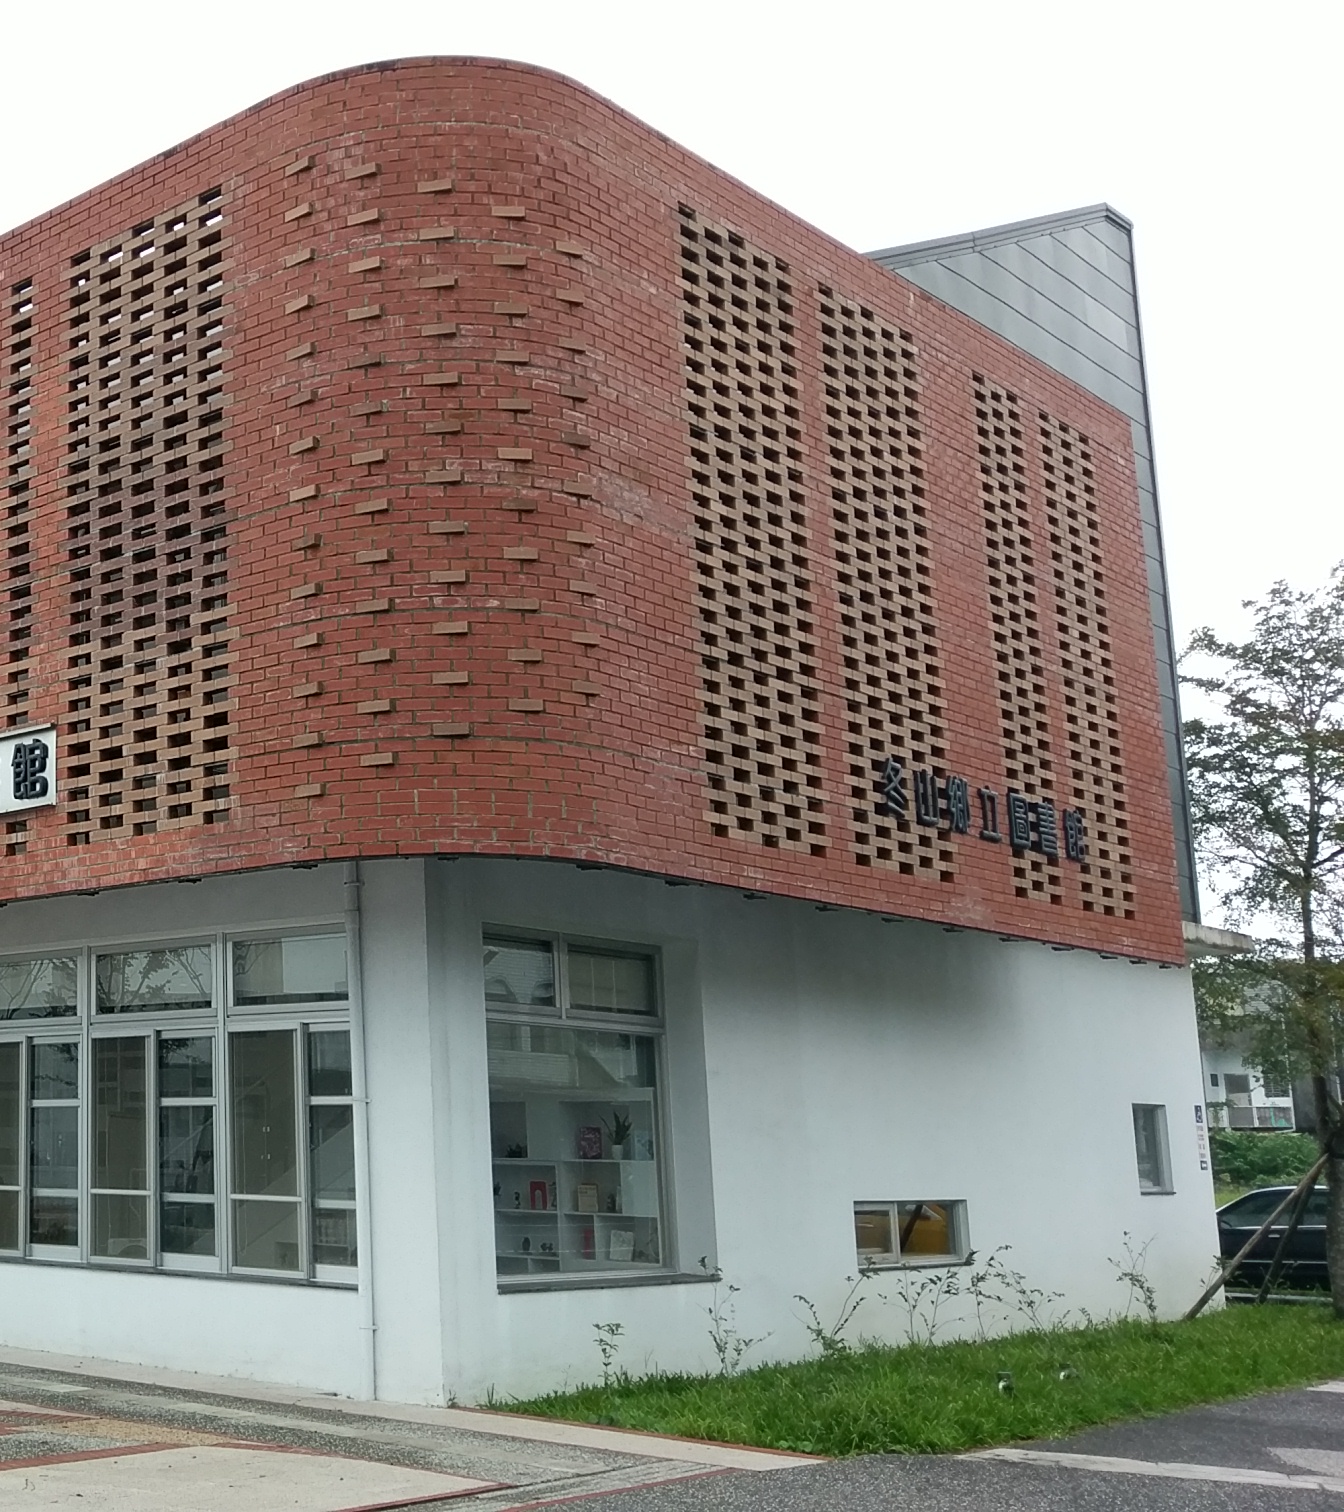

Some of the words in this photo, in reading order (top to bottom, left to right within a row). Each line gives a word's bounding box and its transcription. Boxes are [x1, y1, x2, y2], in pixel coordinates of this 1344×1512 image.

[882, 756, 1087, 863] 冬山鄉立圖書館
